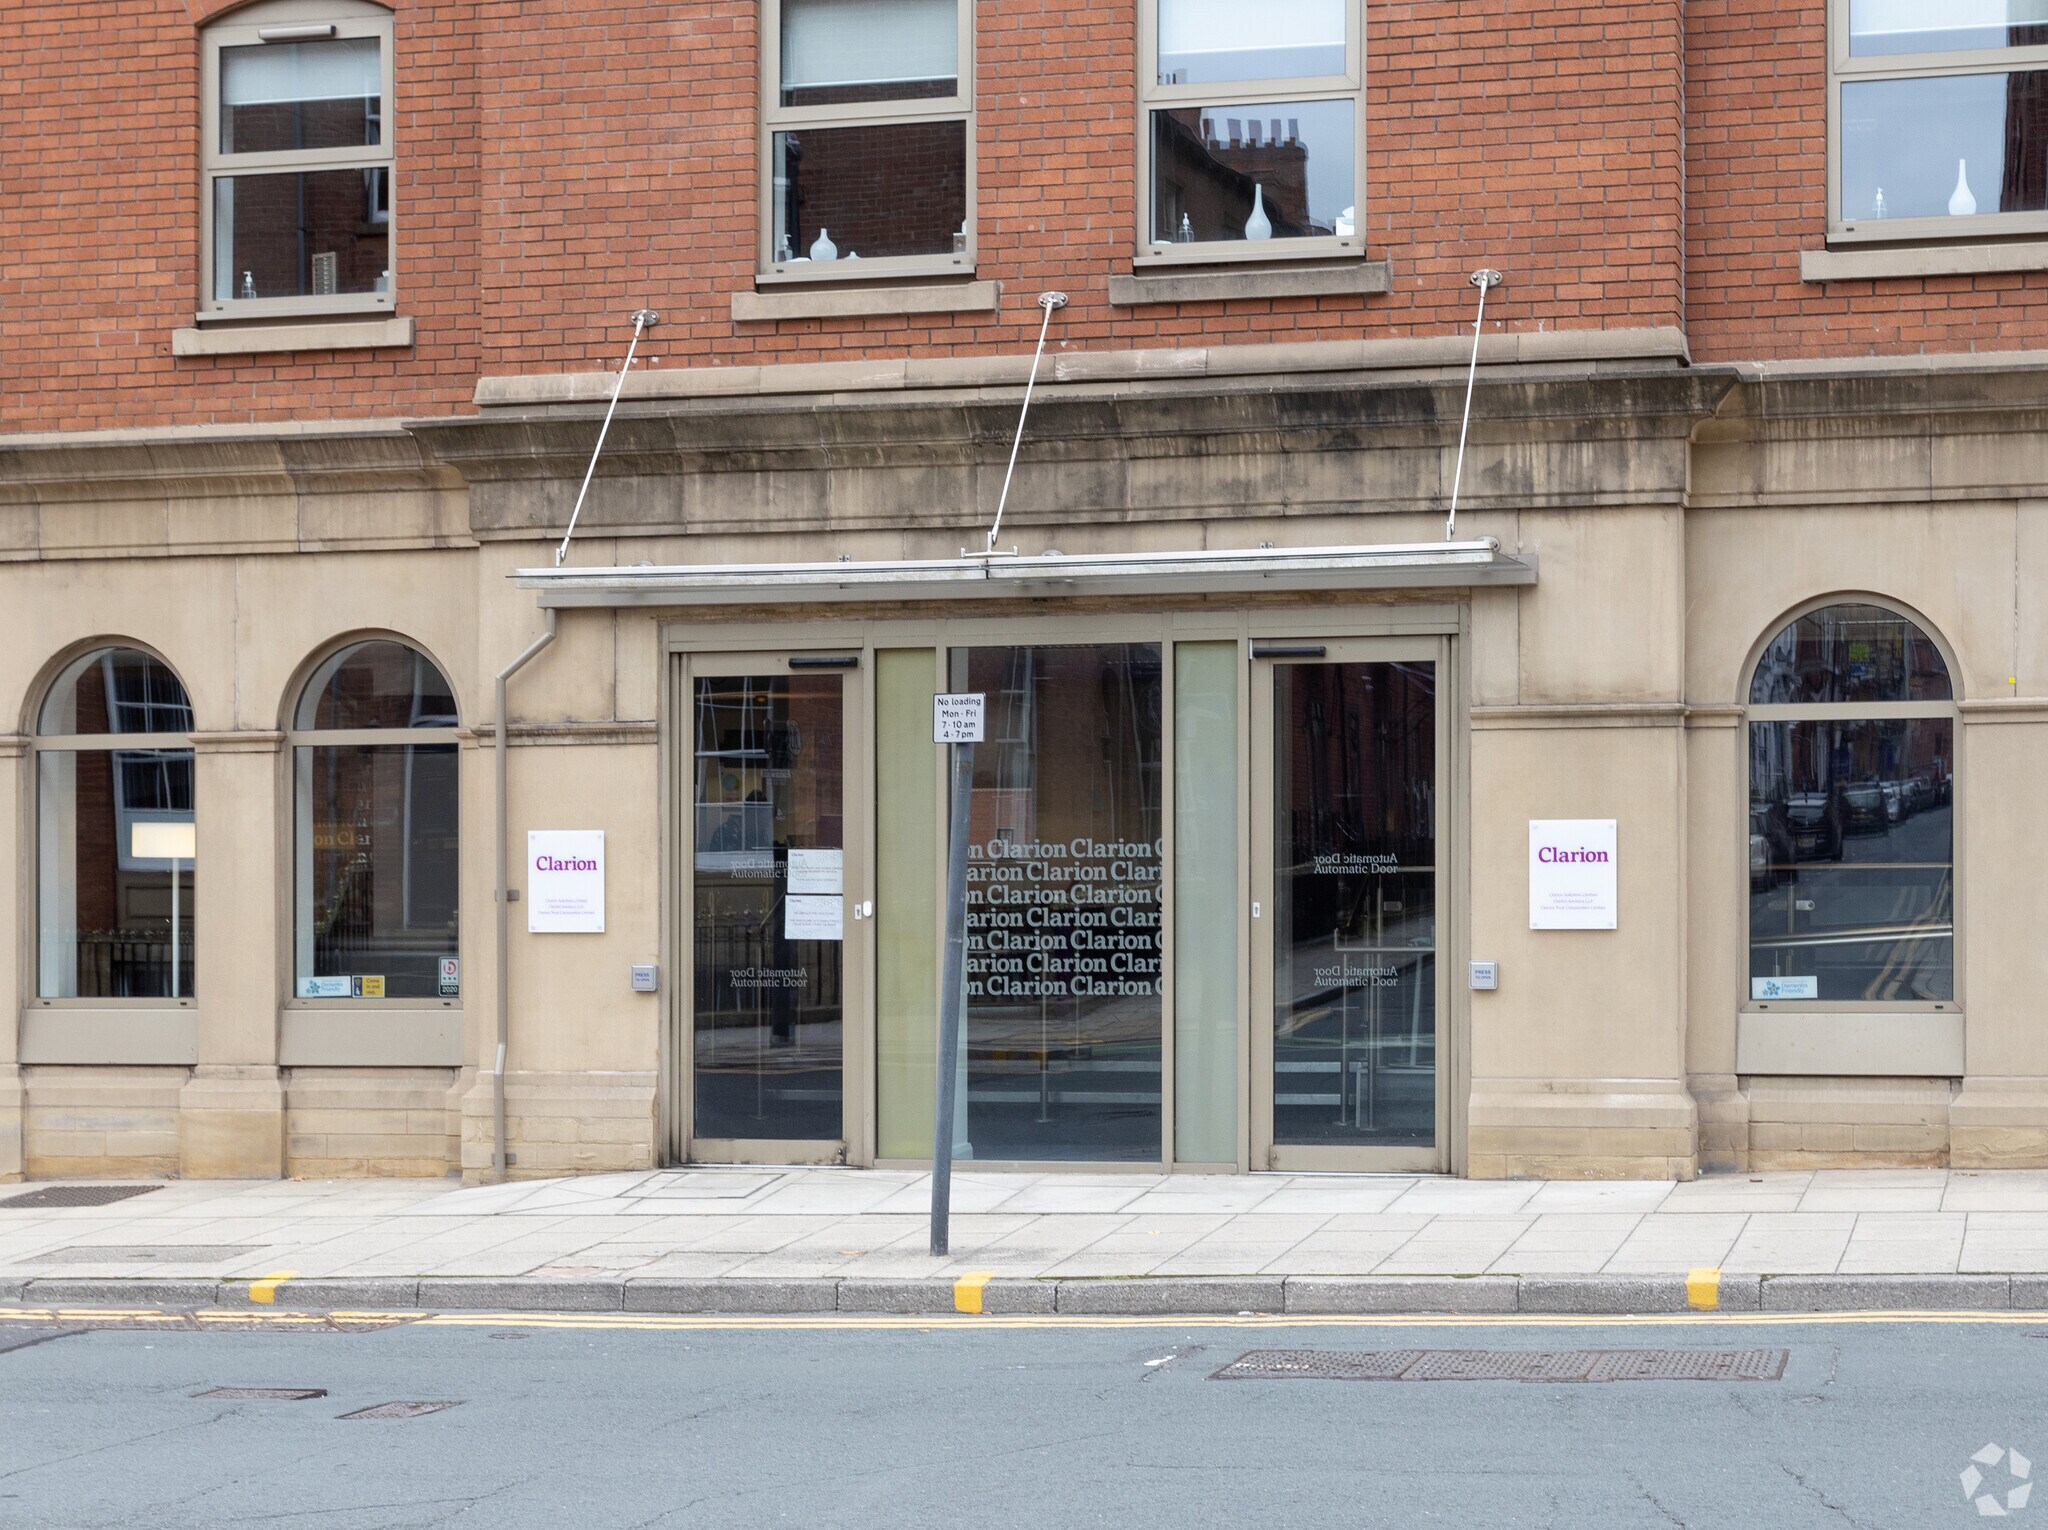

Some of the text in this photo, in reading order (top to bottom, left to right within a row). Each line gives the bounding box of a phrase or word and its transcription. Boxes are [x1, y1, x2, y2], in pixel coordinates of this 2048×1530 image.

[937, 697, 981, 707] No loading
[942, 710, 960, 718] Mon
[965, 709, 977, 717] Fri
[942, 721, 947, 729] 7
[953, 721, 962, 729] 10
[955, 730, 960, 738] 7
[987, 838, 1067, 859] Clarion
[1070, 838, 1152, 859] Clarion
[1538, 846, 1609, 863] Clarion
[536, 855, 598, 871] Clarion
[1026, 861, 1107, 881] Clarion
[1314, 864, 1398, 874] Automatic Door
[731, 869, 783, 879] Automatic
[987, 884, 1067, 904] Clarion
[1070, 884, 1152, 904] Clarion
[1026, 907, 1107, 927] Clarion
[987, 930, 1067, 950] Clarion
[1070, 930, 1152, 950] Clarion
[1026, 953, 1107, 973] Clarion
[730, 978, 808, 988] Automatic Door
[987, 976, 1067, 996] Clarion
[1070, 976, 1152, 996] Clarion
[1314, 976, 1398, 987] Automatic Door
